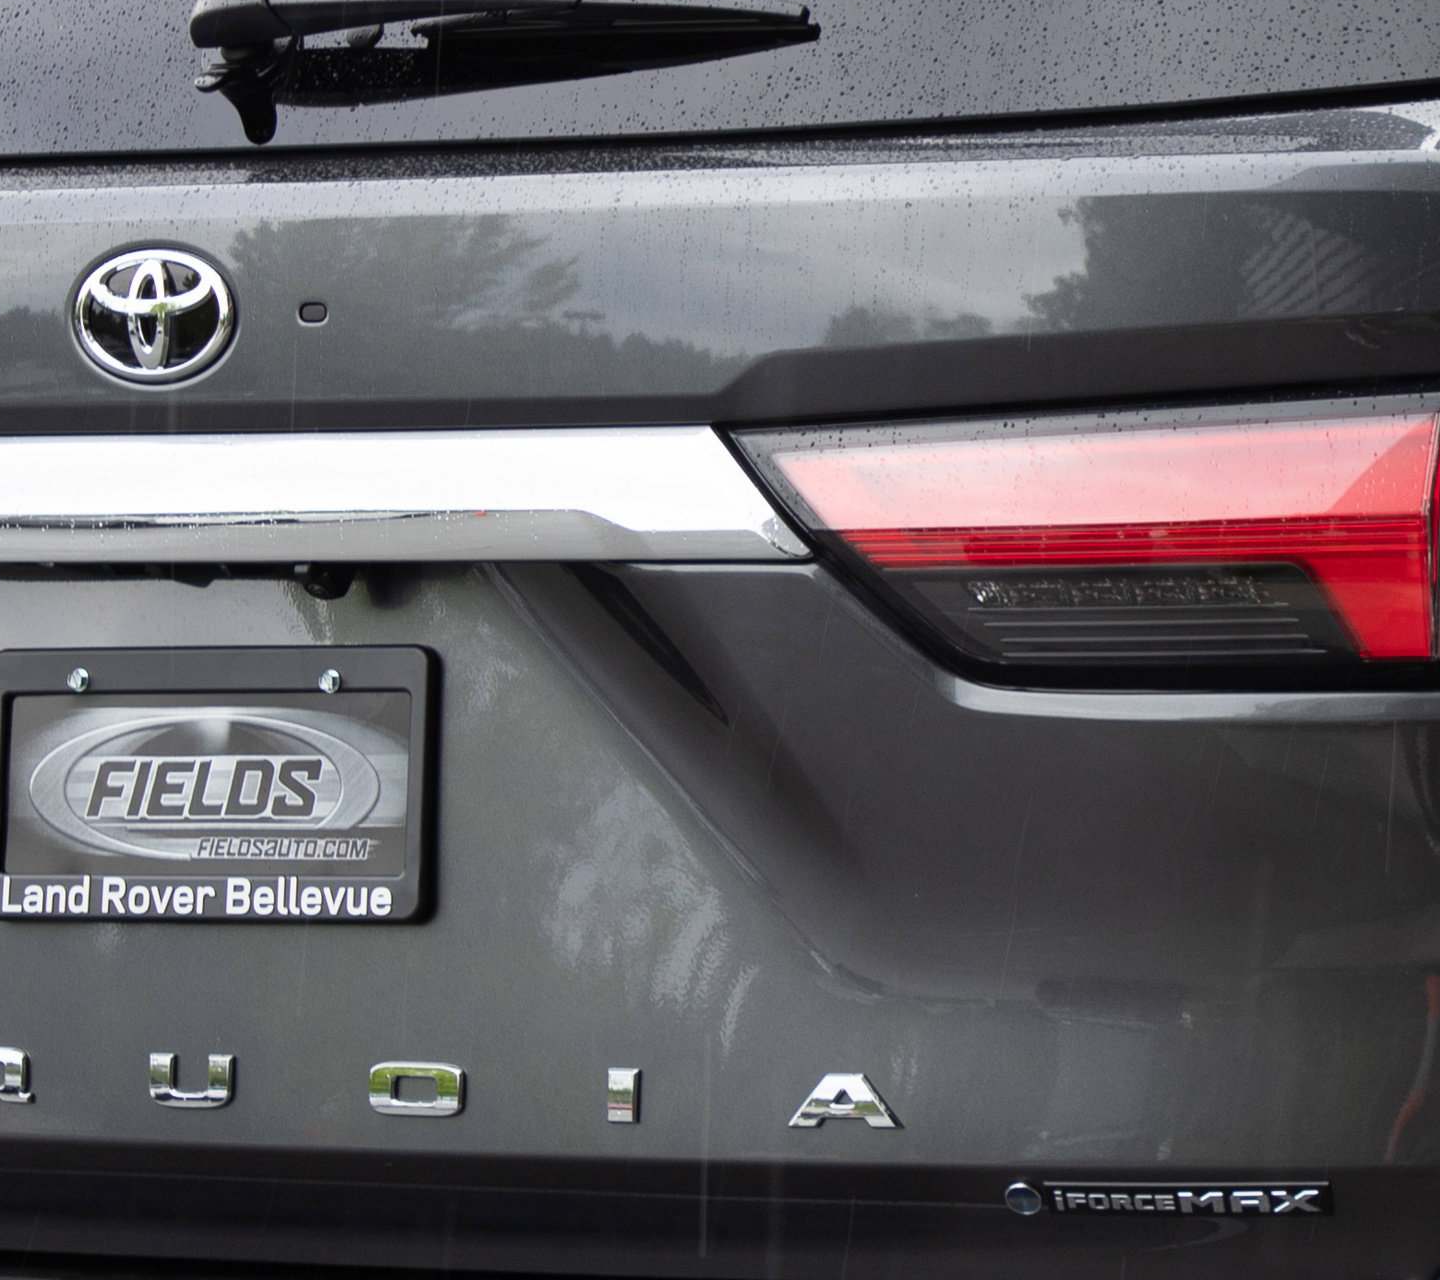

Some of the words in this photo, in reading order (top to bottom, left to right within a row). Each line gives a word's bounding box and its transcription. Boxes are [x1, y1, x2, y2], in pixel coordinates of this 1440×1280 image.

[85, 758, 323, 819] FIELDS
[1, 875, 90, 913] Land
[101, 877, 215, 915] Rover
[226, 877, 392, 916] Bellevue
